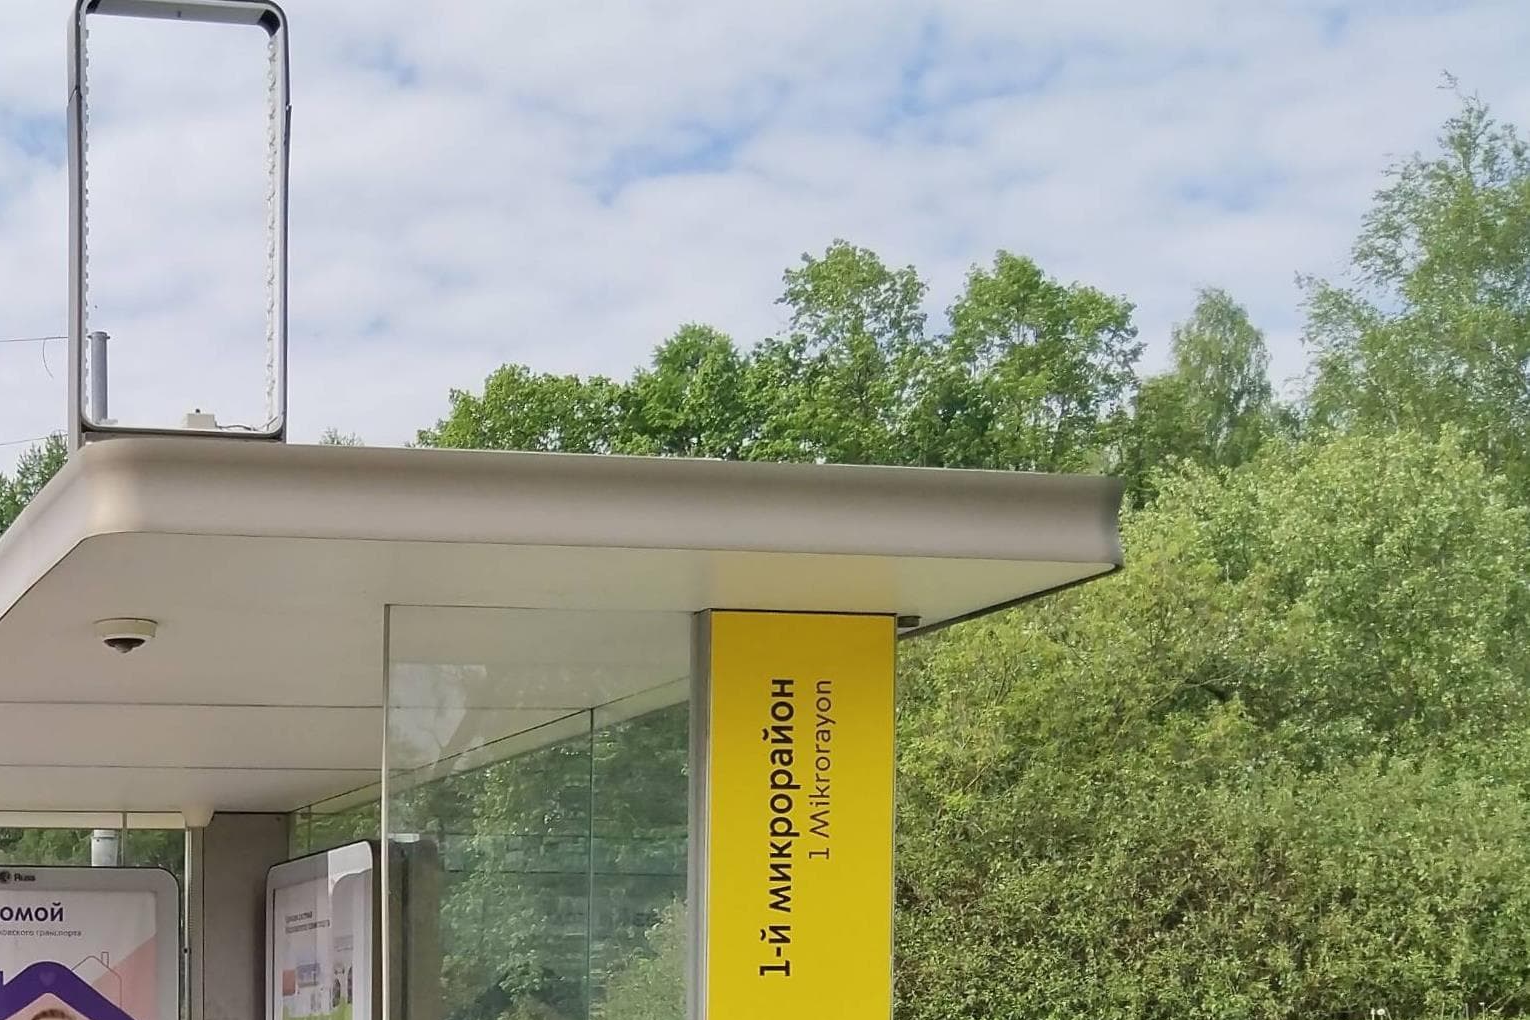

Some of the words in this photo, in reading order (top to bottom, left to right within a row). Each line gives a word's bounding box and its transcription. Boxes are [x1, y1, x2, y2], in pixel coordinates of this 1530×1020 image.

[808, 679, 836, 838] Mikrorayon
[761, 678, 801, 913] микрорайон
[808, 847, 830, 860] 1
[36, 929, 82, 938] транспорта
[759, 923, 791, 977] 1-й
